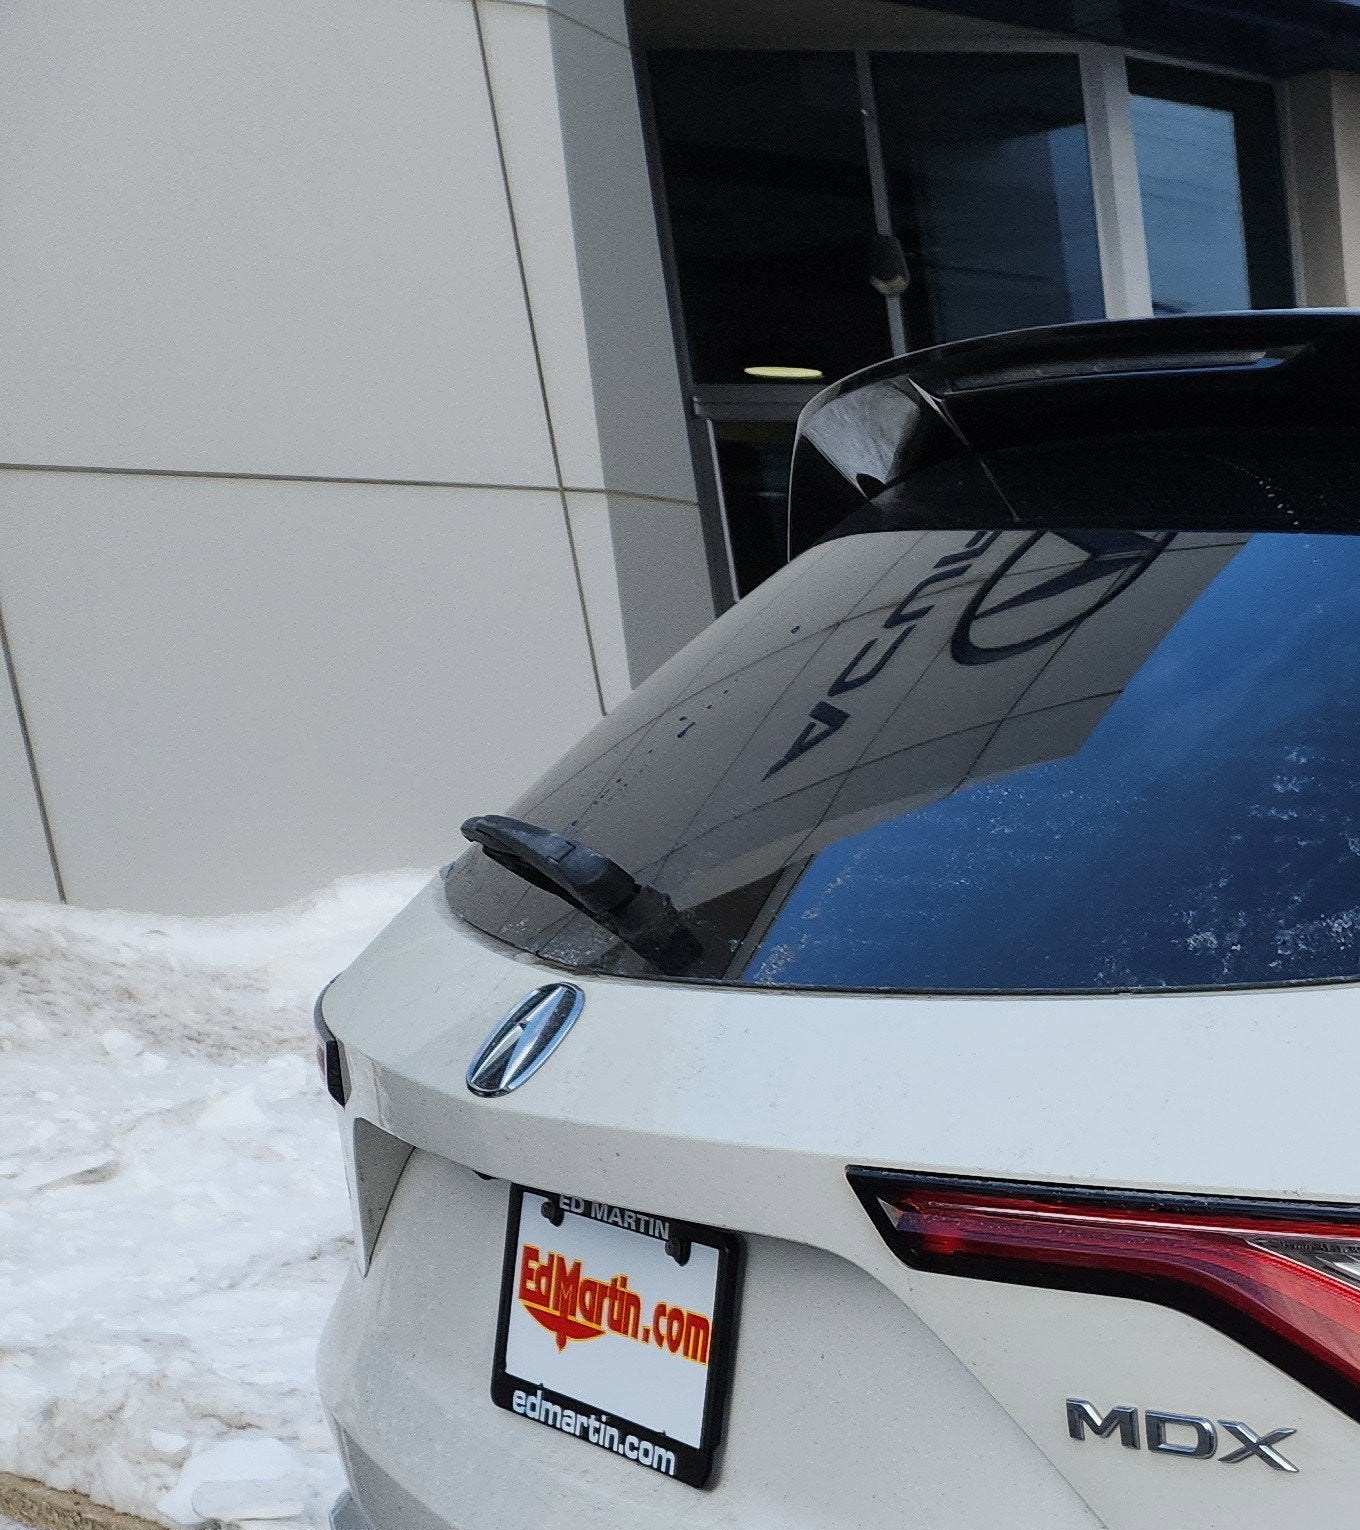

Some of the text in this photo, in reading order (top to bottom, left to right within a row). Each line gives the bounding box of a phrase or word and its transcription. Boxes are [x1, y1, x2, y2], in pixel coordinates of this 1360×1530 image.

[559, 1195, 670, 1240] ED MARTIN
[518, 1244, 712, 1365] EdMartin.com
[512, 1389, 676, 1476] edmartin.com
[1065, 1397, 1300, 1473] MDX
